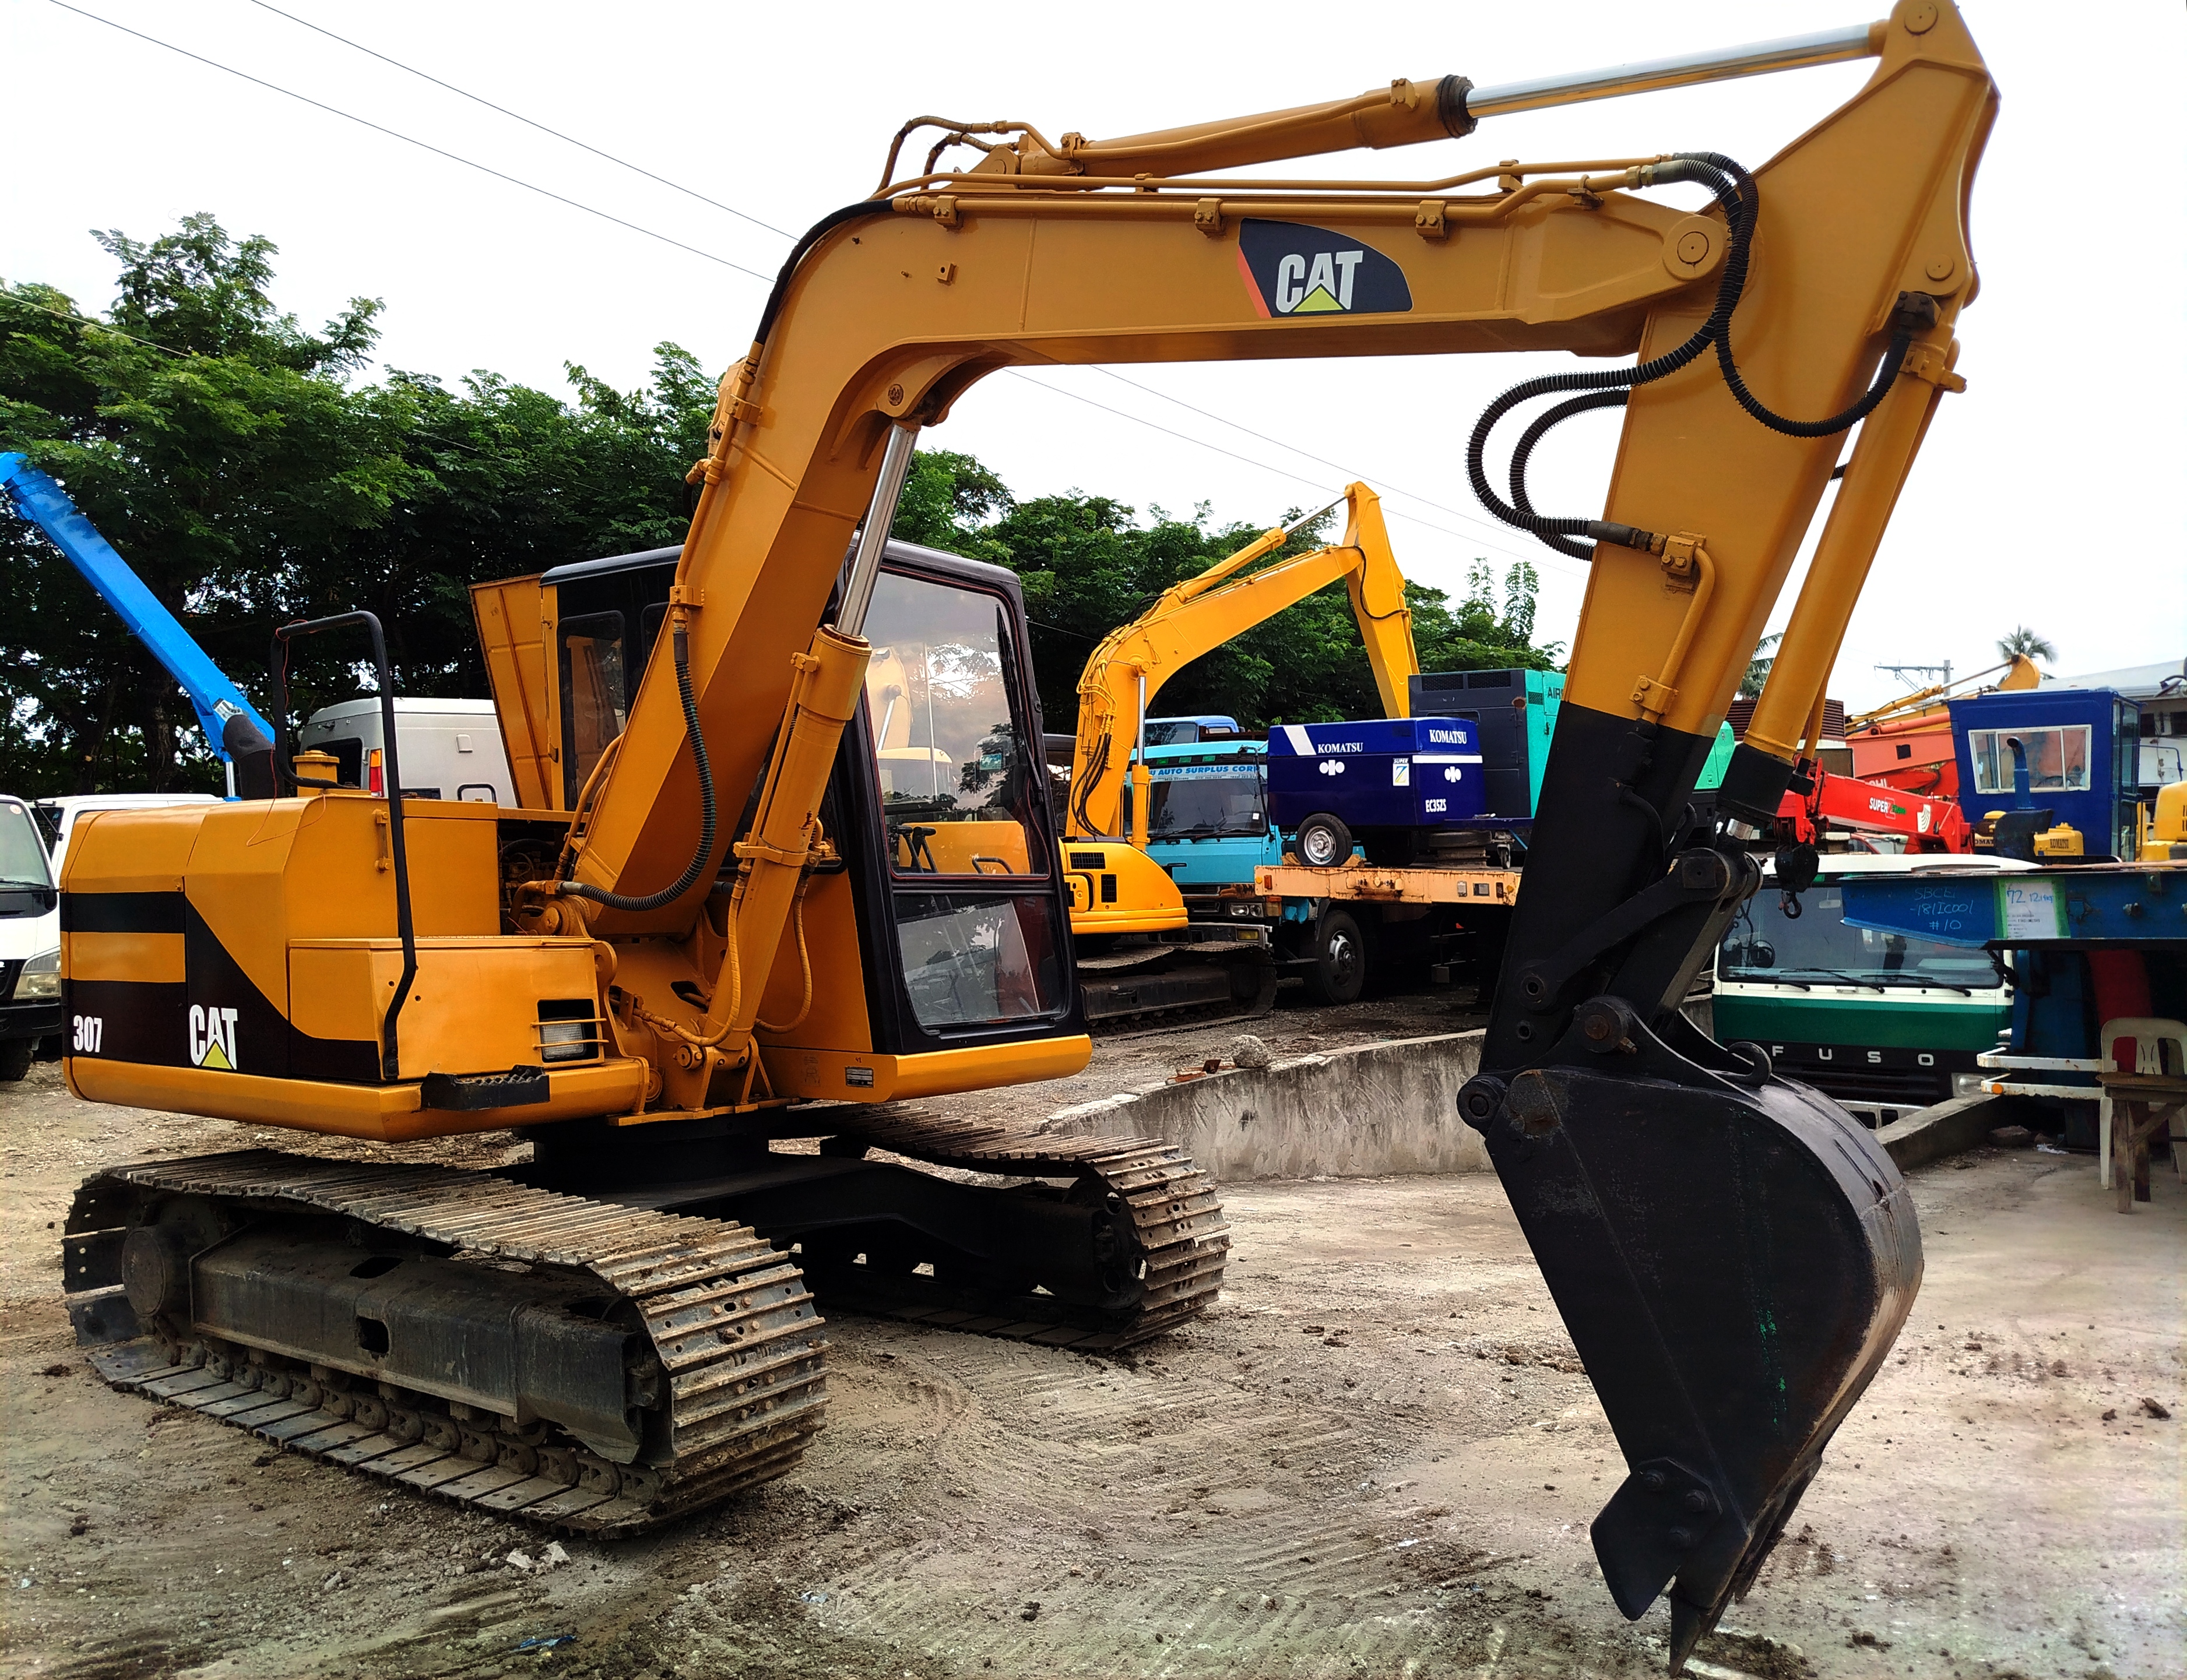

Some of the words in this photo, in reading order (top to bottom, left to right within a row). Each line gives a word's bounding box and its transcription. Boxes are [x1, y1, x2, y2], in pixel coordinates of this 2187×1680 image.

[1276, 251, 1363, 313] CAT
[1429, 729, 1467, 744] KOMATSU
[1318, 742, 1363, 753] KOMATSU
[1185, 766, 1229, 774] SURPLUS
[1426, 799, 1447, 812] EC35ZS
[1869, 797, 1888, 813] SUPER
[2049, 839, 2069, 848] KOMATSU
[2007, 890, 2026, 904] 72
[73, 1015, 103, 1053] 307
[189, 1004, 238, 1070] CAT
